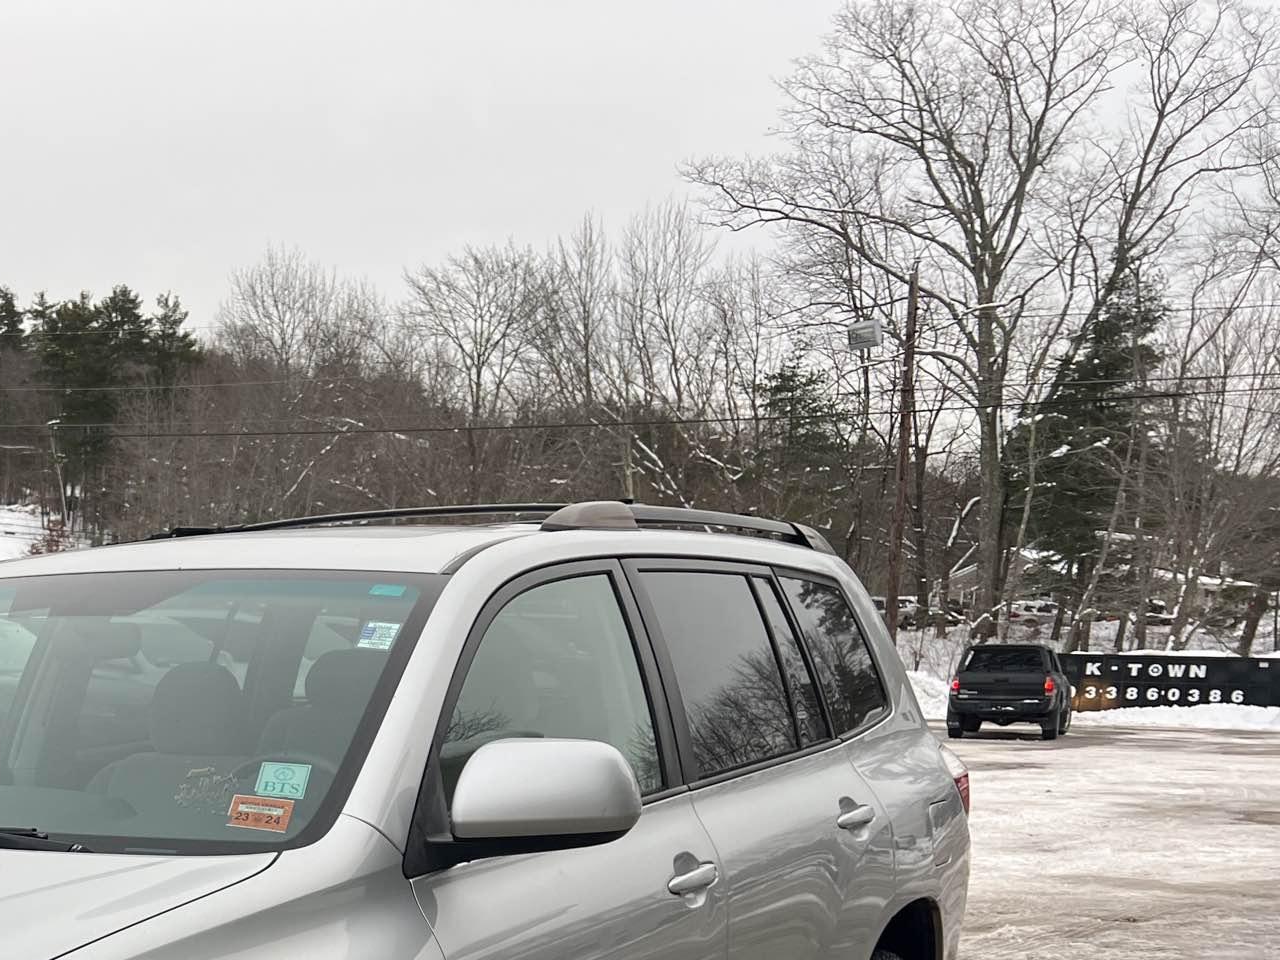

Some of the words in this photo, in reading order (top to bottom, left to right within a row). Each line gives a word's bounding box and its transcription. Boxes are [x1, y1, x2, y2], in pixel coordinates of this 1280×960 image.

[263, 781, 300, 794] BTS
[234, 811, 250, 822] 23
[264, 815, 281, 825] 24
